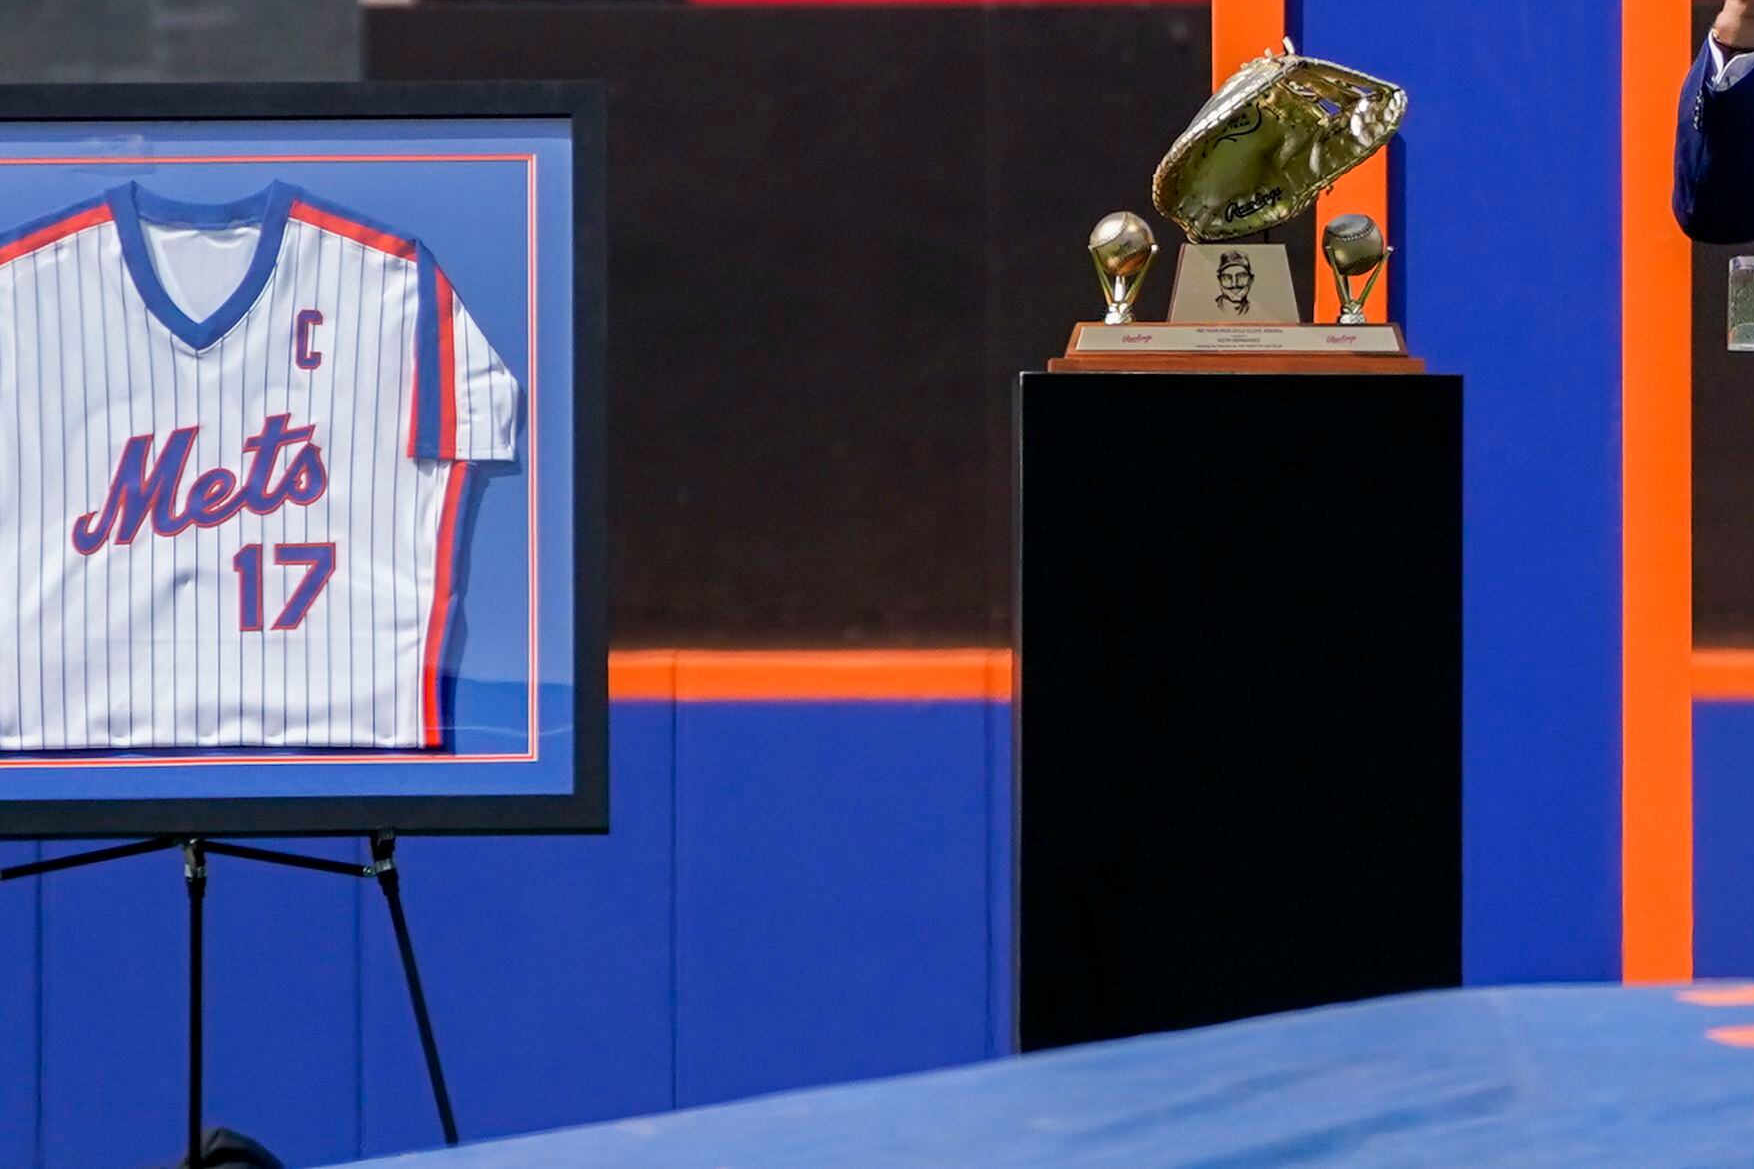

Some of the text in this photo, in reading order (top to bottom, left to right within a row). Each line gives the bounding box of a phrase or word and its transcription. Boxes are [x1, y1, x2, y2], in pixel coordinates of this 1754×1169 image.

[295, 309, 323, 370] C
[72, 412, 328, 556] Mets
[233, 541, 337, 632] 17
